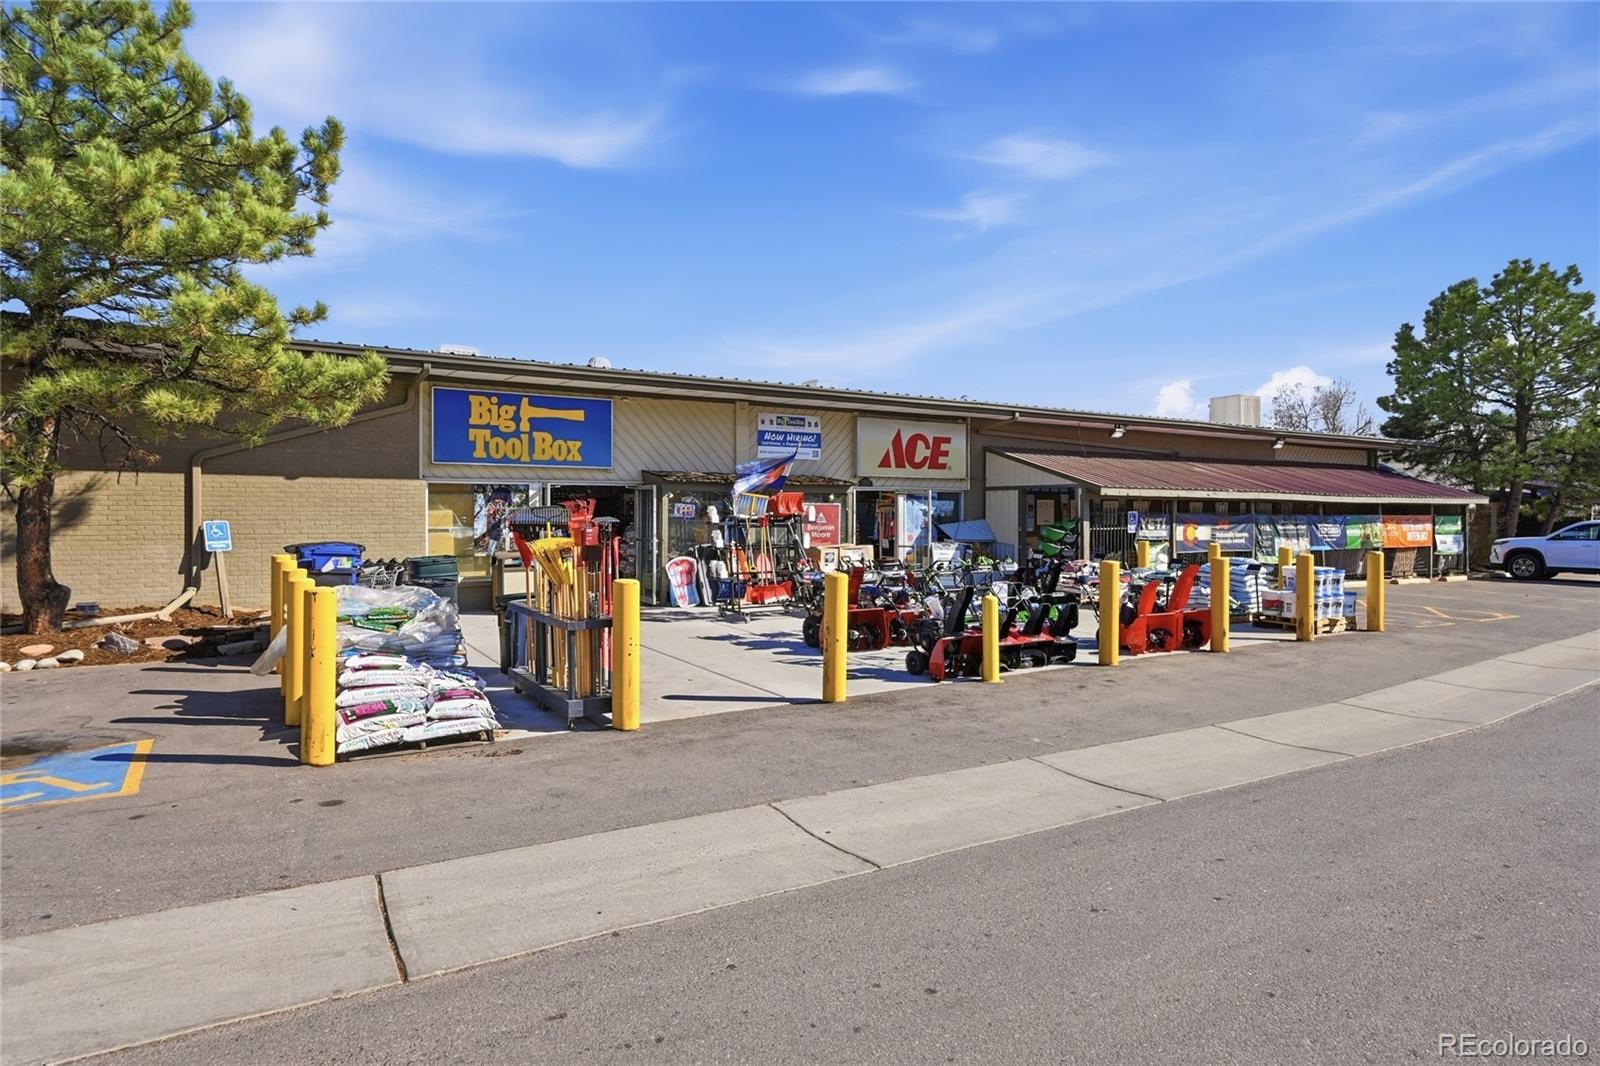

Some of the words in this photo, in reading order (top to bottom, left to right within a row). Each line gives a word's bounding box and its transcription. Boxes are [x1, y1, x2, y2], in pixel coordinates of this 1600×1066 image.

[469, 395, 517, 432] Big
[469, 429, 530, 462] Tool
[532, 432, 582, 462] Box
[764, 432, 785, 441] NOW
[786, 433, 817, 443] HIRING!
[877, 428, 952, 470] ACE
[807, 524, 835, 532] Benjamin
[1140, 517, 1166, 530] YETI
